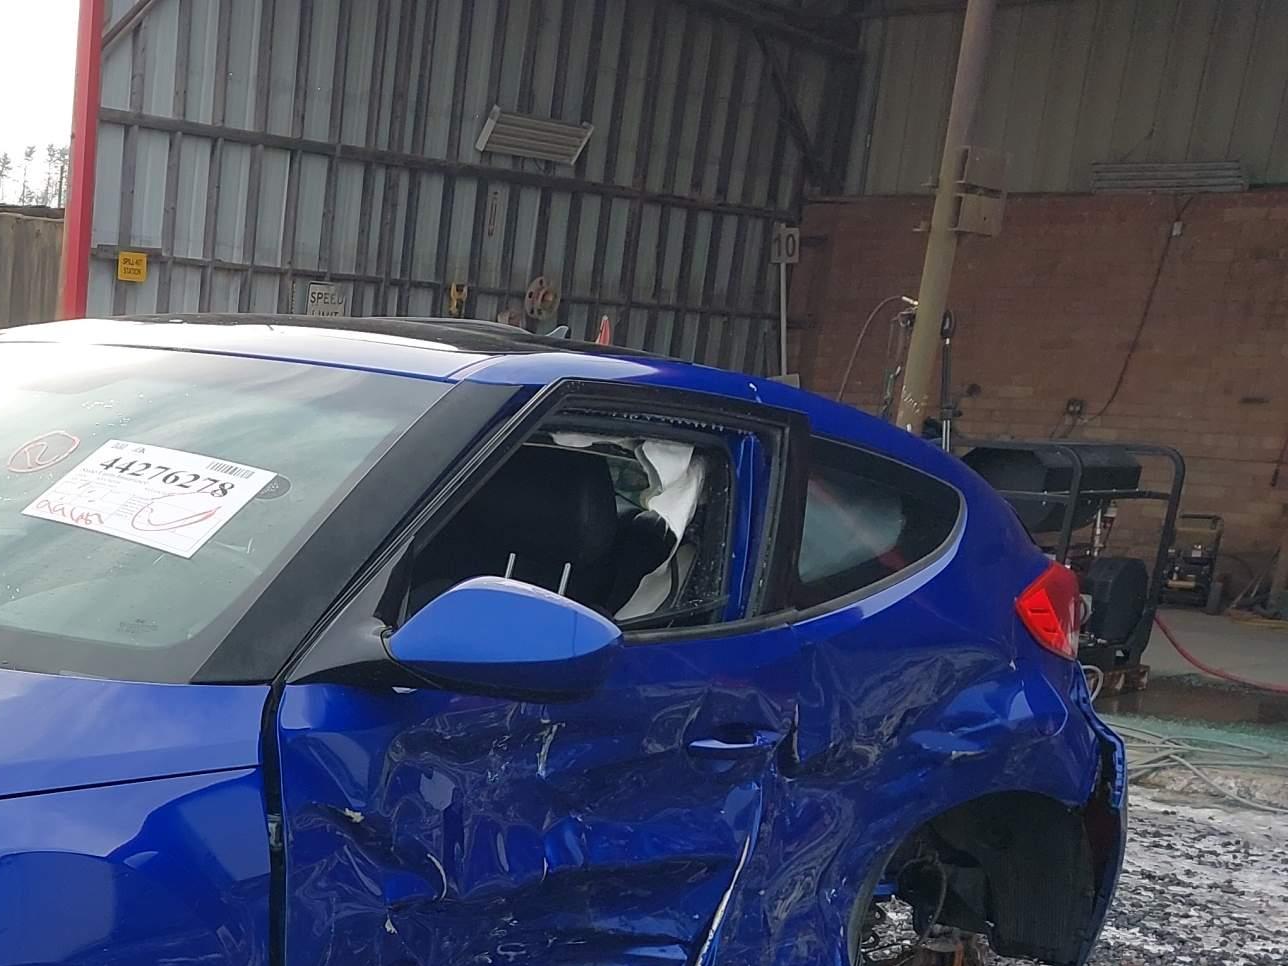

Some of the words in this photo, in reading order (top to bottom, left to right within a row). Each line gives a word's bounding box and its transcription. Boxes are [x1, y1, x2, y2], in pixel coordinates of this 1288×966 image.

[776, 233, 795, 257] 10
[310, 291, 344, 305] SPEED
[99, 456, 235, 498] 44276278
